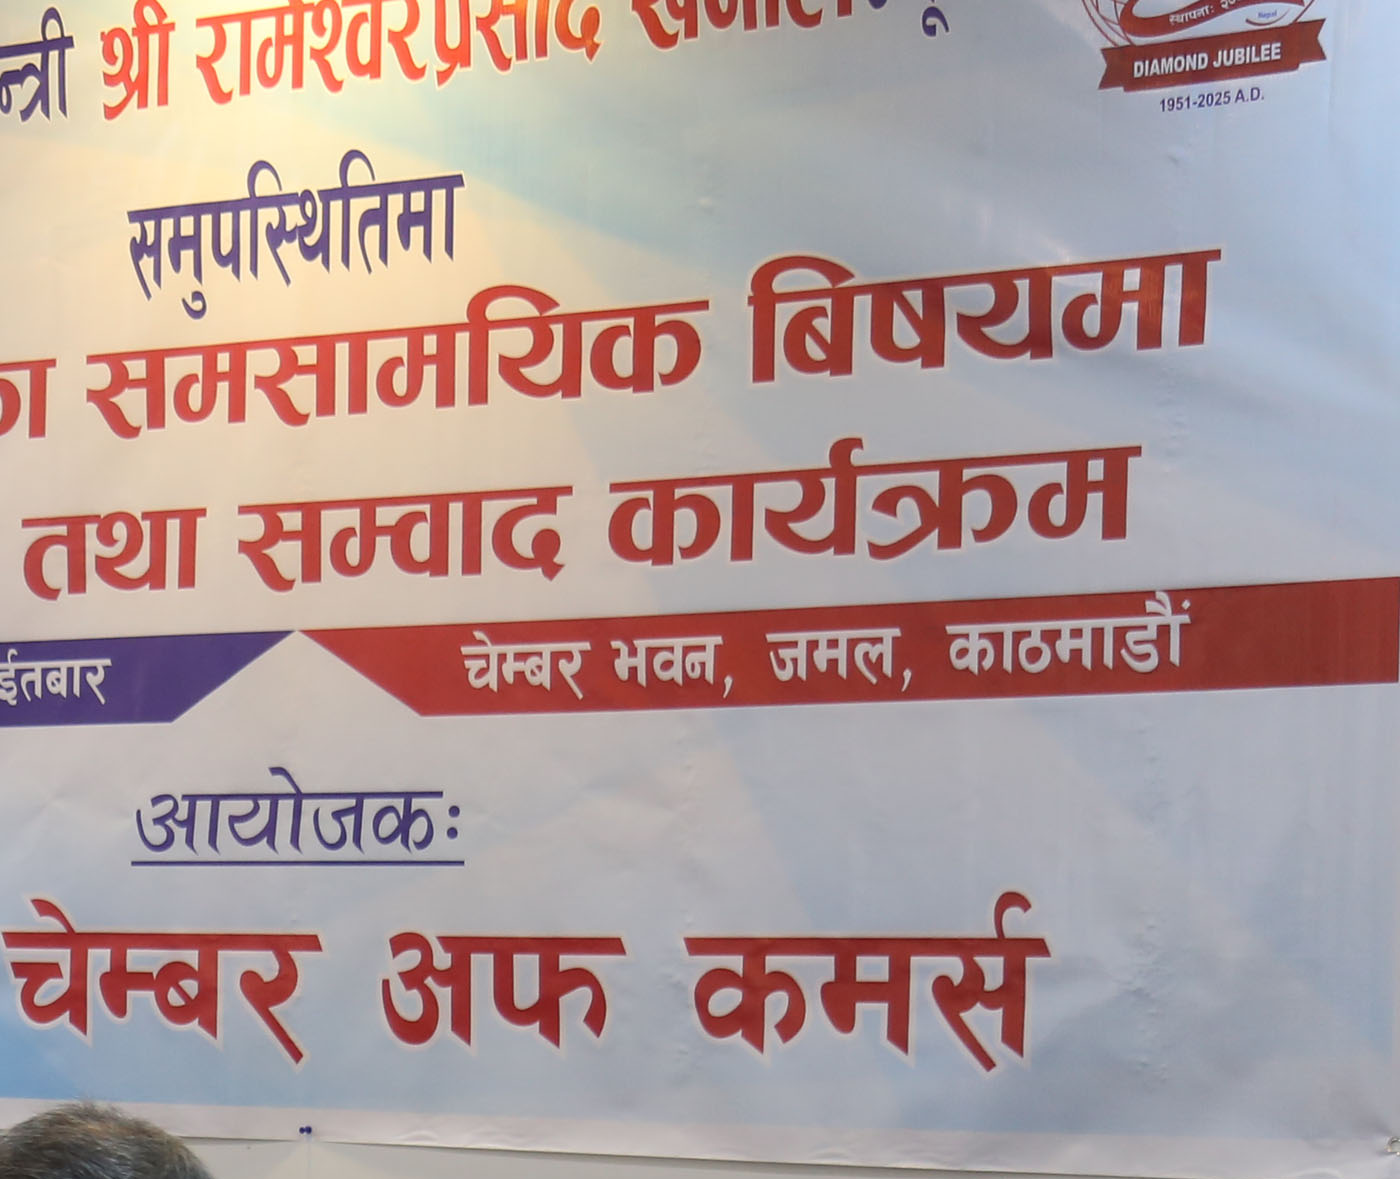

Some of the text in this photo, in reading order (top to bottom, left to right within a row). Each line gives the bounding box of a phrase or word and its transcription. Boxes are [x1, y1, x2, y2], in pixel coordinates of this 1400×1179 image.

[101, 0, 176, 120] श्री
[1133, 42, 1282, 79] DIAMOND JUBILEE
[1159, 86, 1265, 113] 1951-2025 A.D.
[127, 149, 464, 320] समुपस्थितिमा
[85, 284, 710, 440] समसामयिक
[747, 248, 1222, 385] बिषयमा
[22, 507, 207, 600] तथा
[237, 484, 573, 592] सम्वाद
[607, 437, 1142, 568] कार्यक्रम
[461, 591, 1192, 701] चेम्बर भवन, जमल, काठमाडौं
[1, 896, 323, 1066] चेम्बर
[383, 930, 627, 1048] अफ
[682, 889, 1052, 1072] कमर्स
